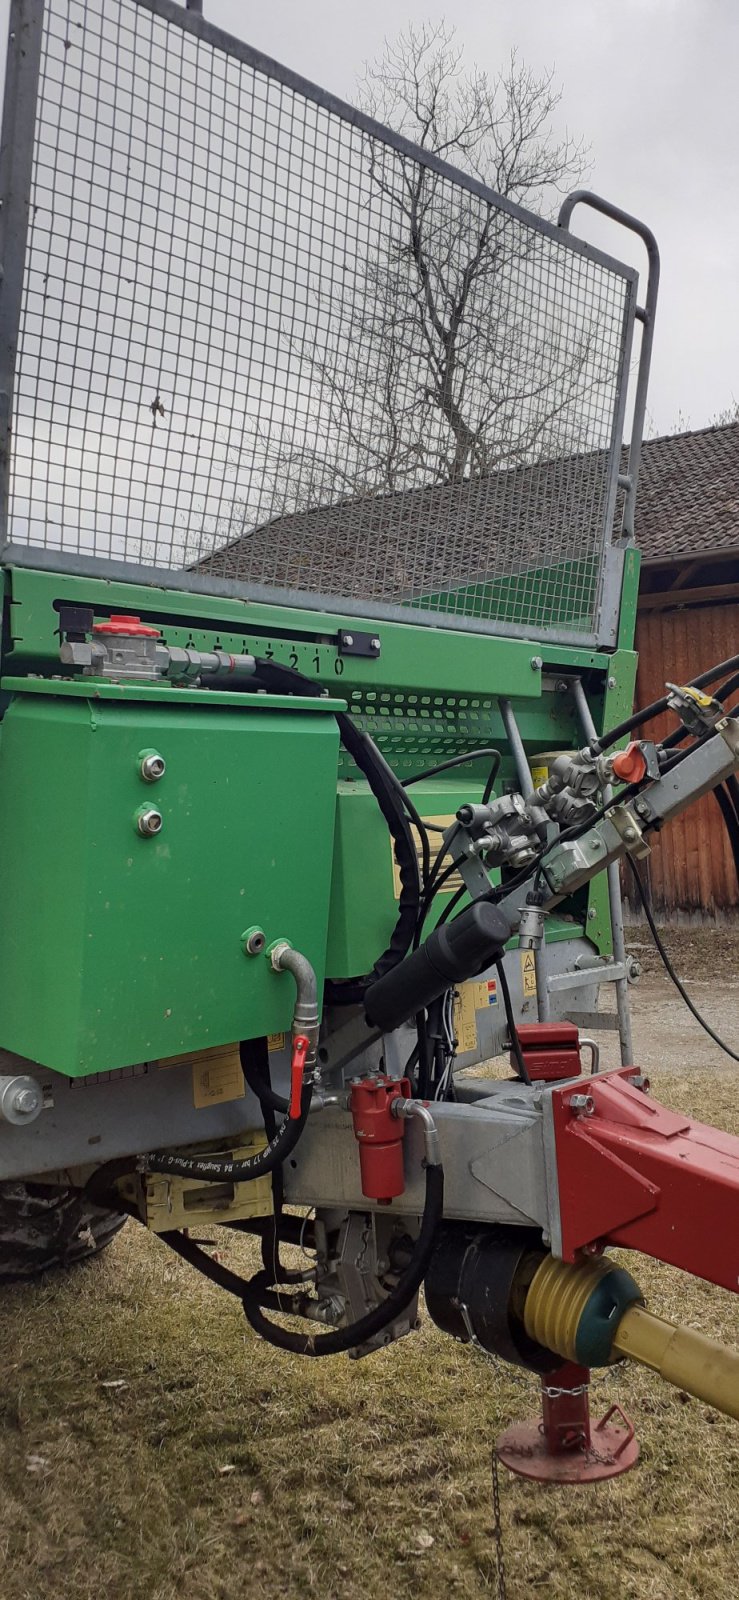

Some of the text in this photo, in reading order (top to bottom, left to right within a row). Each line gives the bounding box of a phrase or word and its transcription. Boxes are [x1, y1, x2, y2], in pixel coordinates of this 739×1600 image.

[289, 654, 299, 671] 2
[312, 656, 320, 673] 1
[334, 658, 344, 675] 0
[196, 1161, 222, 1173] Saugflex
[224, 1163, 234, 1173] R4
[241, 1159, 251, 1169] bar
